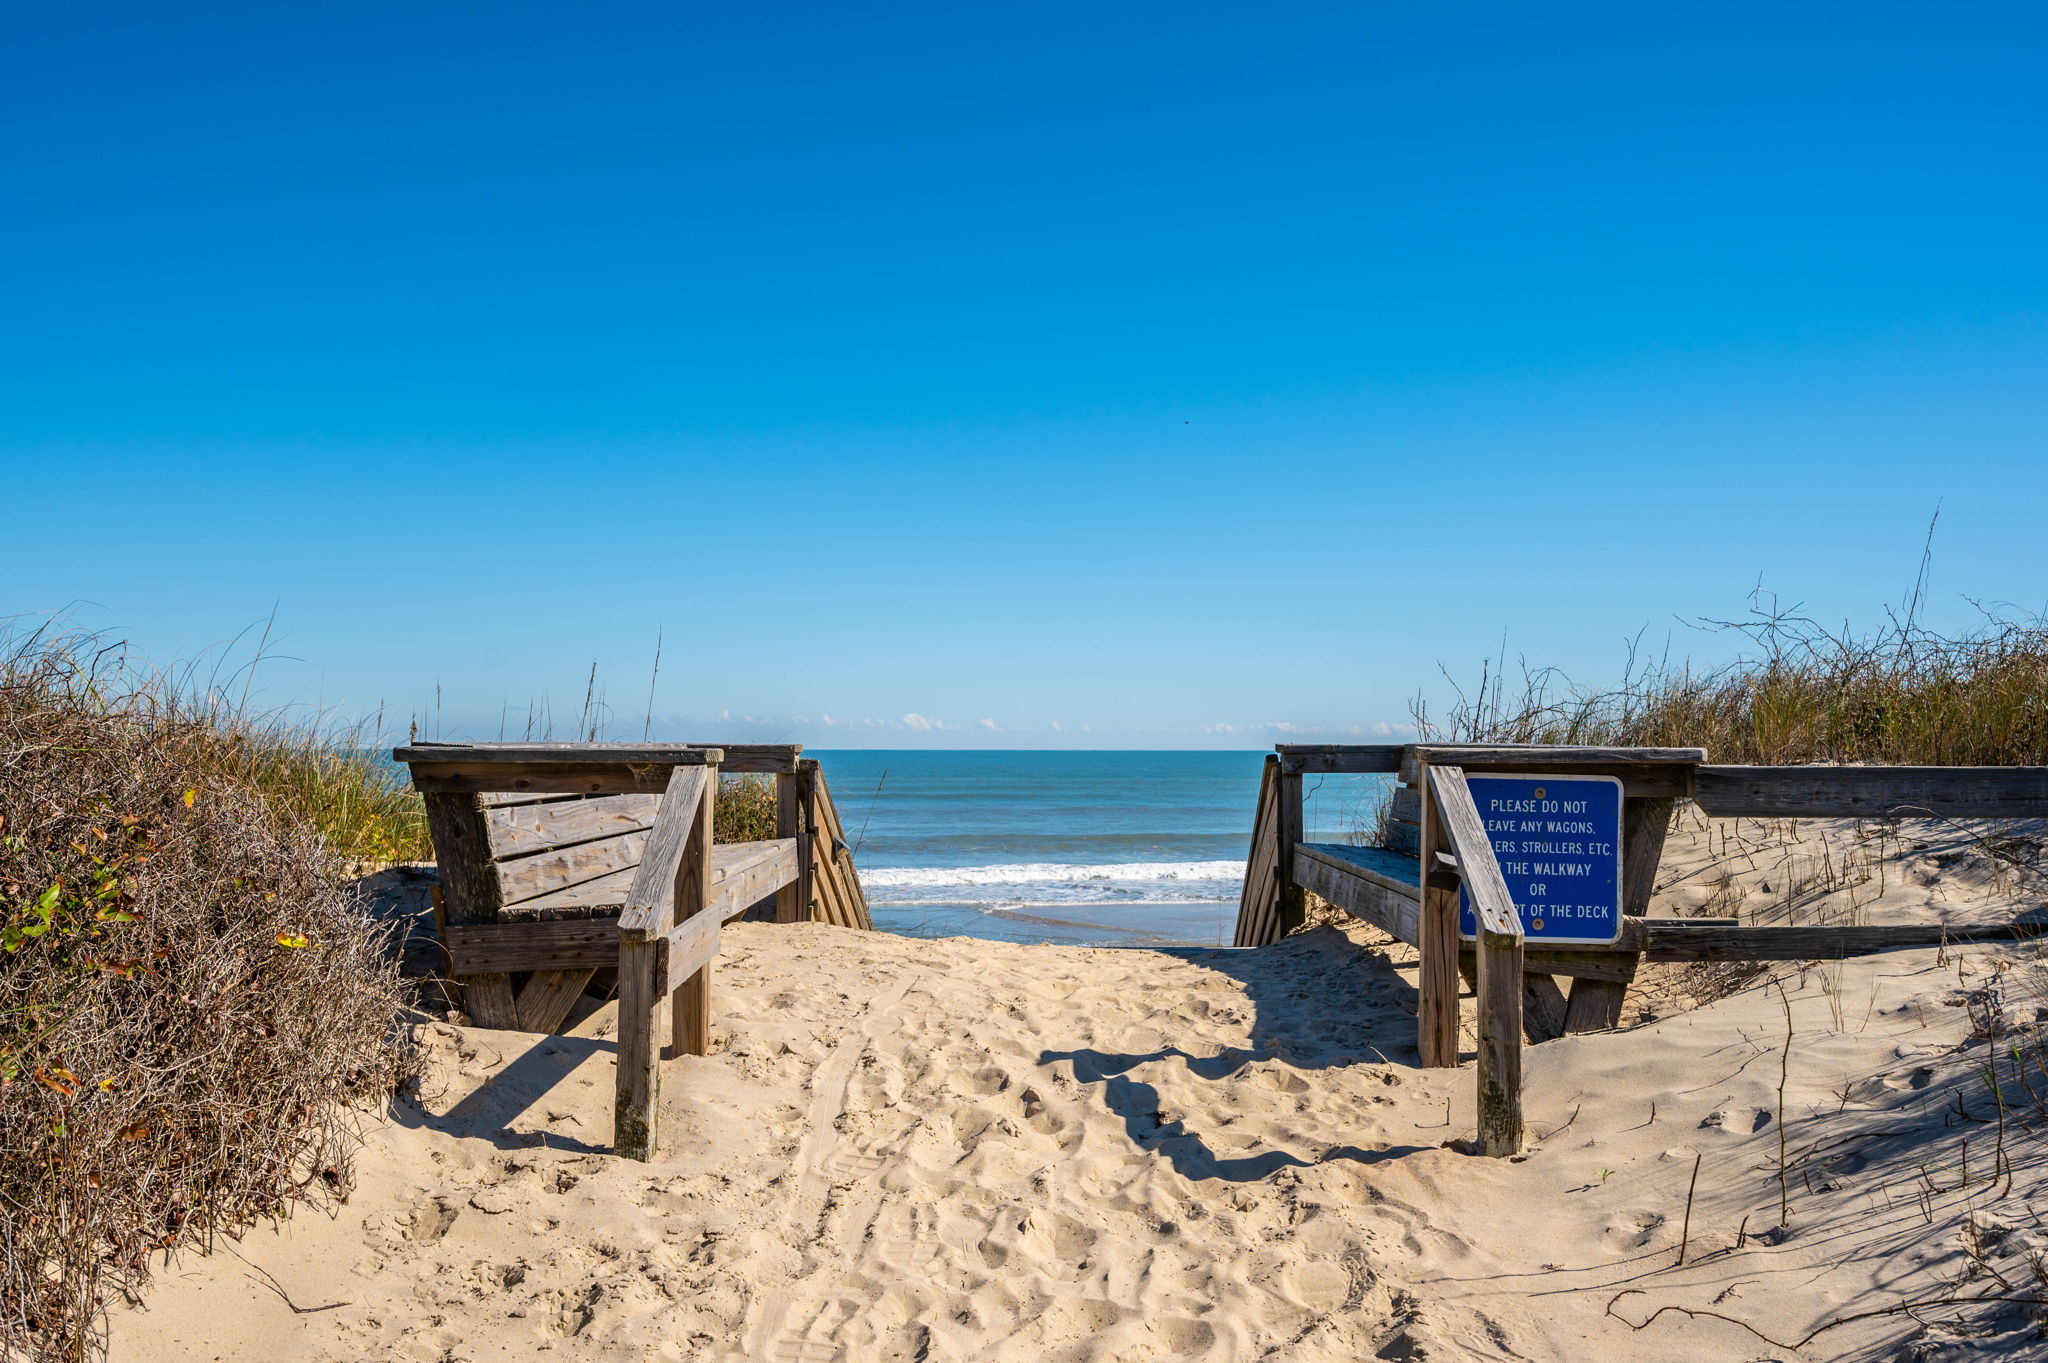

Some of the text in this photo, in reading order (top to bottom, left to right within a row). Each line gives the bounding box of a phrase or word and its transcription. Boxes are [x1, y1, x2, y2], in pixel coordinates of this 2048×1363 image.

[1491, 799, 1588, 814] PLEASE DO NOT
[1520, 821, 1543, 833] ANY
[1588, 843, 1613, 856] ETC.
[1506, 861, 1529, 875] THE
[1533, 863, 1592, 876] WALKWAY
[1529, 883, 1546, 896] OR
[1530, 904, 1546, 917] OF
[1550, 905, 1573, 917] THE
[1577, 905, 1609, 919] DECK
